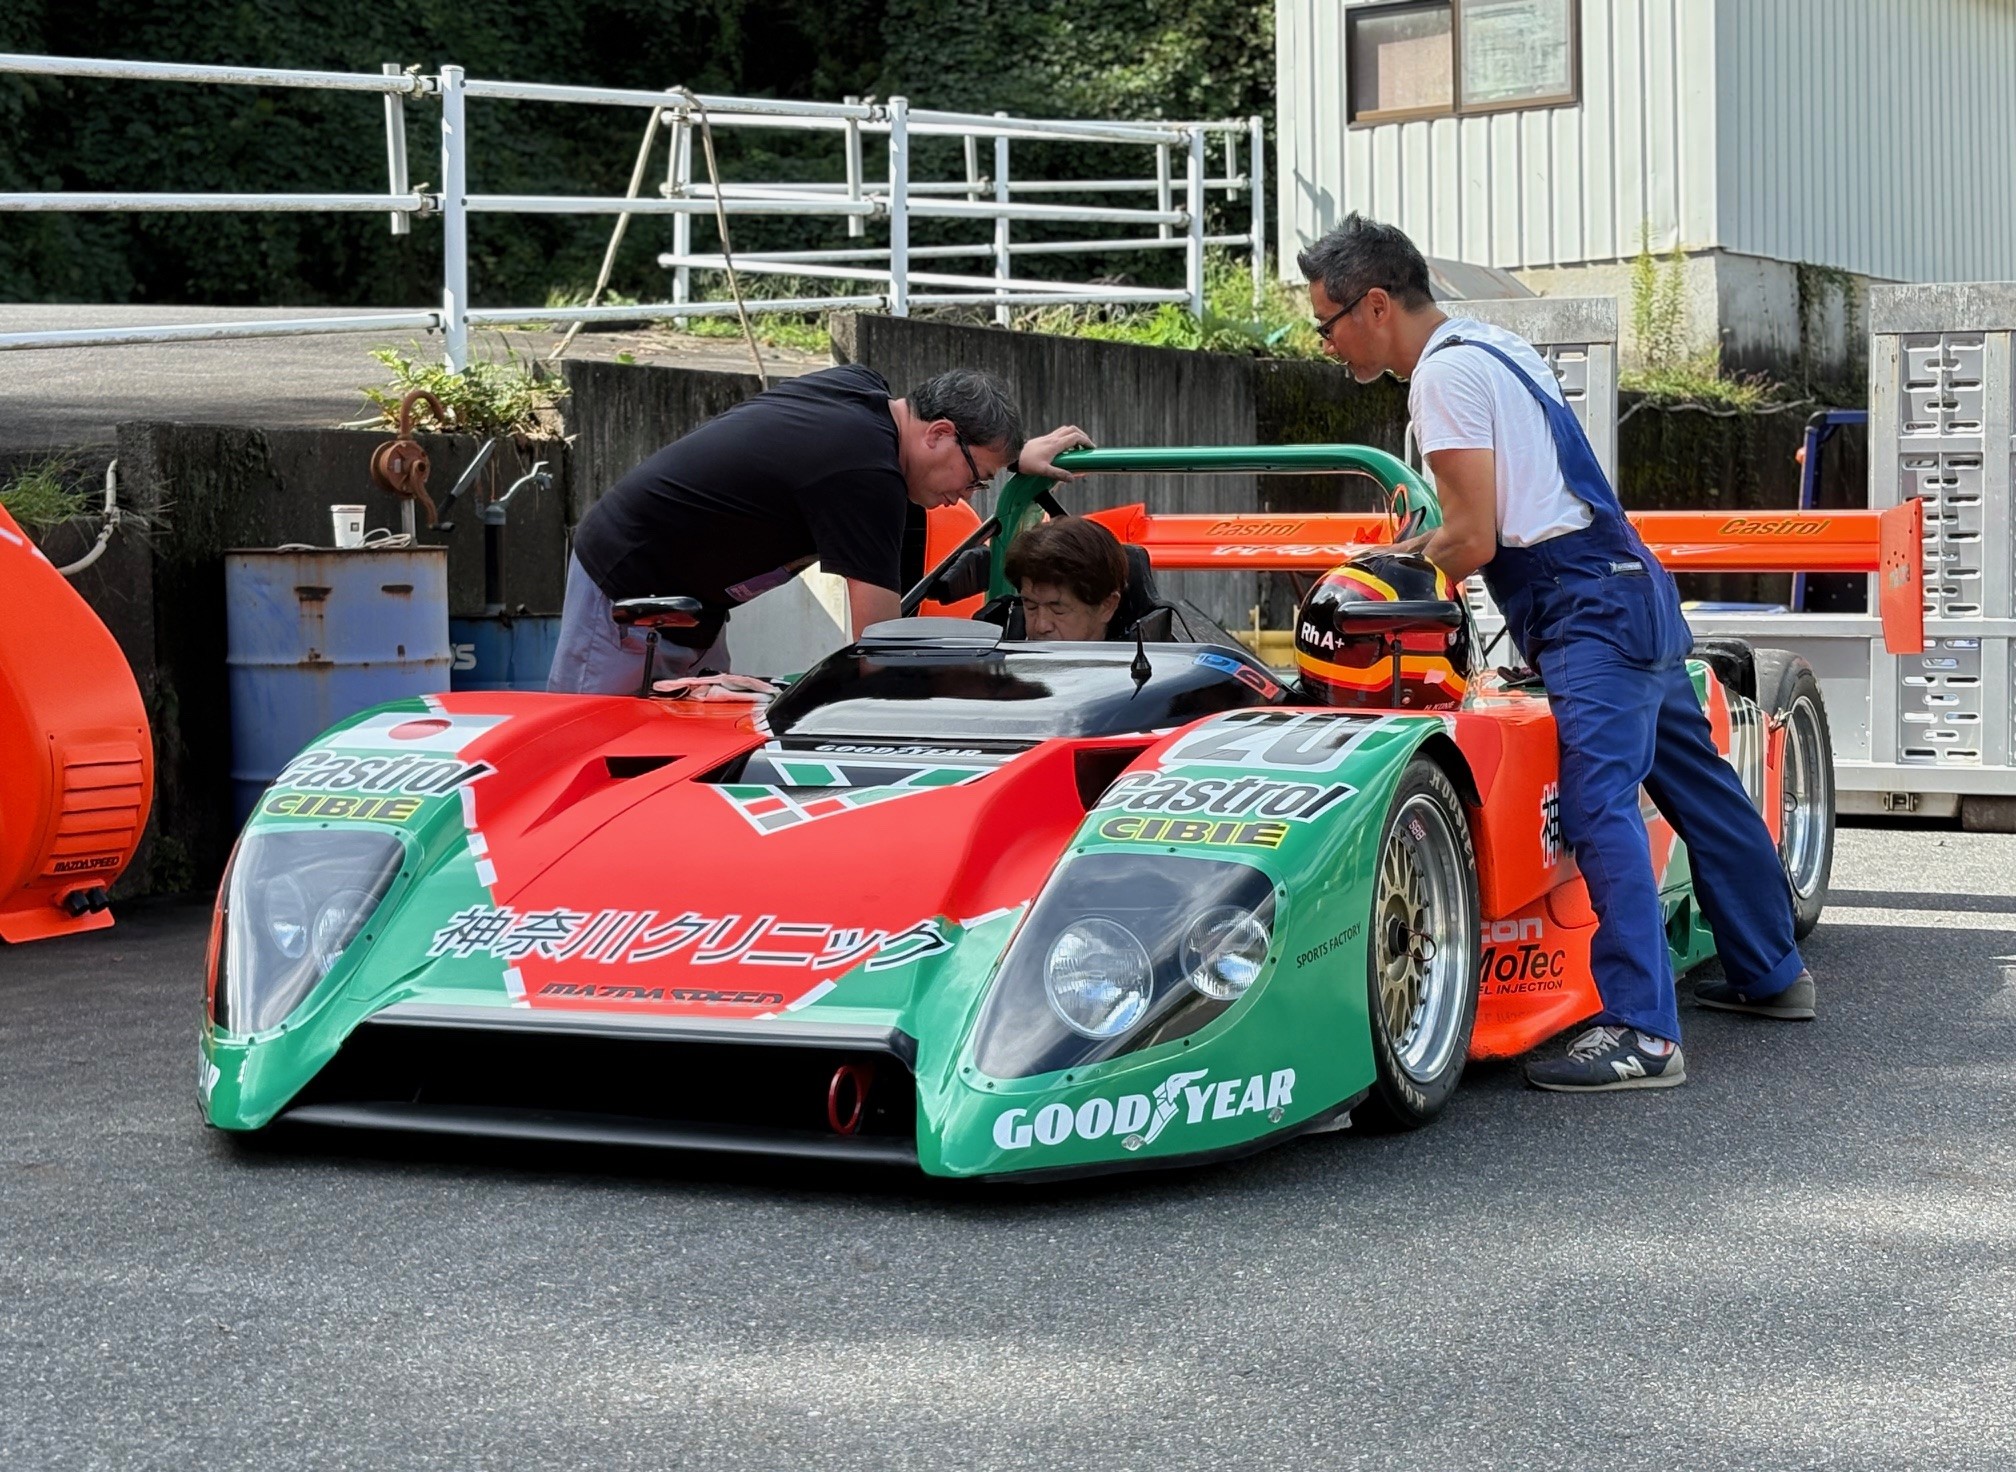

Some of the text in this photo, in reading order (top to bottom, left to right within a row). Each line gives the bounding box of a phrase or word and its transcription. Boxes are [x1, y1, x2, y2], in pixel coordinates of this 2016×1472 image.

[1205, 521, 1305, 537] Castrol
[1718, 518, 1831, 535] Castrol
[1172, 710, 1384, 766] 20
[277, 750, 499, 796] Castrol
[1097, 771, 1358, 823] Castrol
[427, 904, 955, 973] 神奈川クリニック
[1296, 920, 1361, 969] SPORTS FACTORY
[1496, 979, 1563, 995] INJECTION
